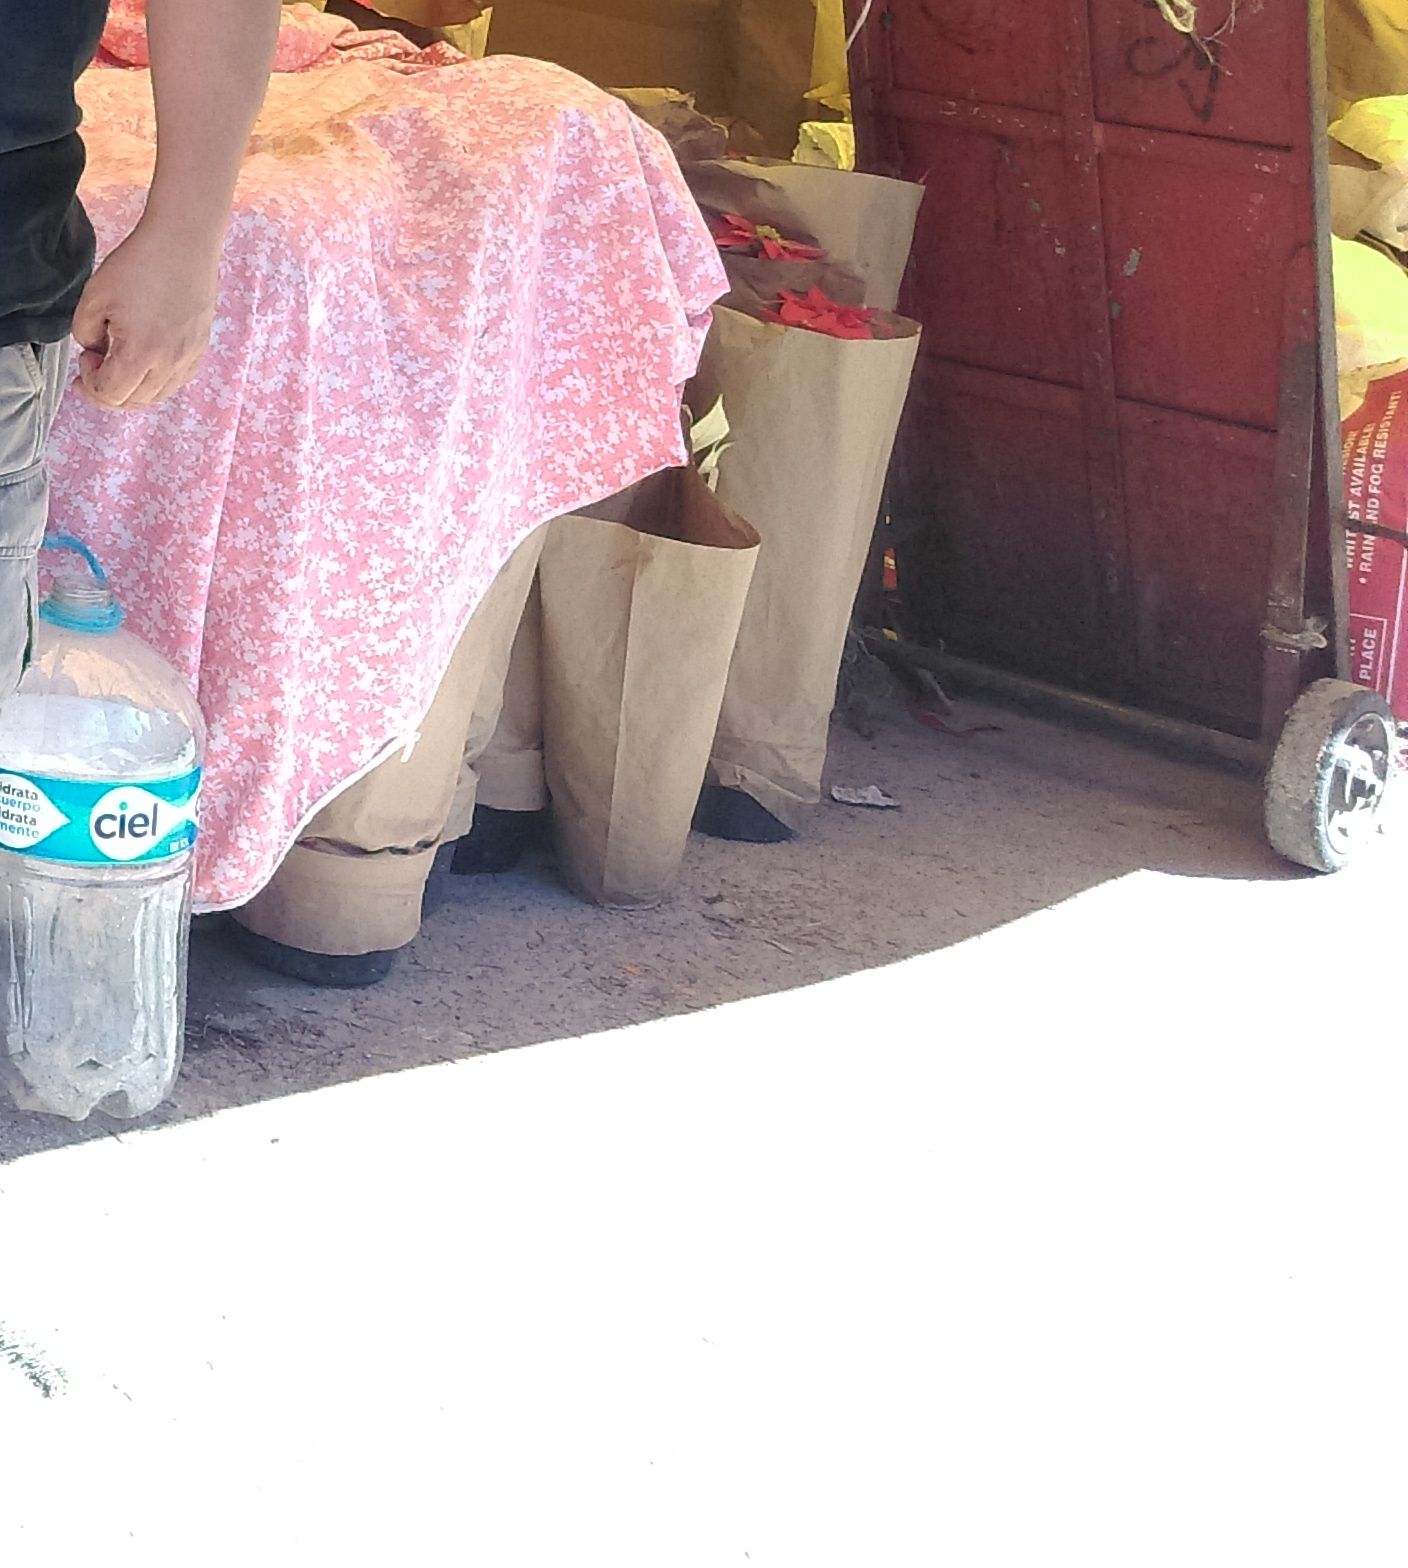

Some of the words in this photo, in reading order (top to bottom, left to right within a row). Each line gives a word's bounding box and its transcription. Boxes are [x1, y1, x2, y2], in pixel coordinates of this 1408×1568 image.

[1361, 537, 1376, 573] RAIN
[1369, 462, 1385, 495] FOG
[1359, 627, 1378, 681] PLACE
[94, 802, 158, 839] ciel
